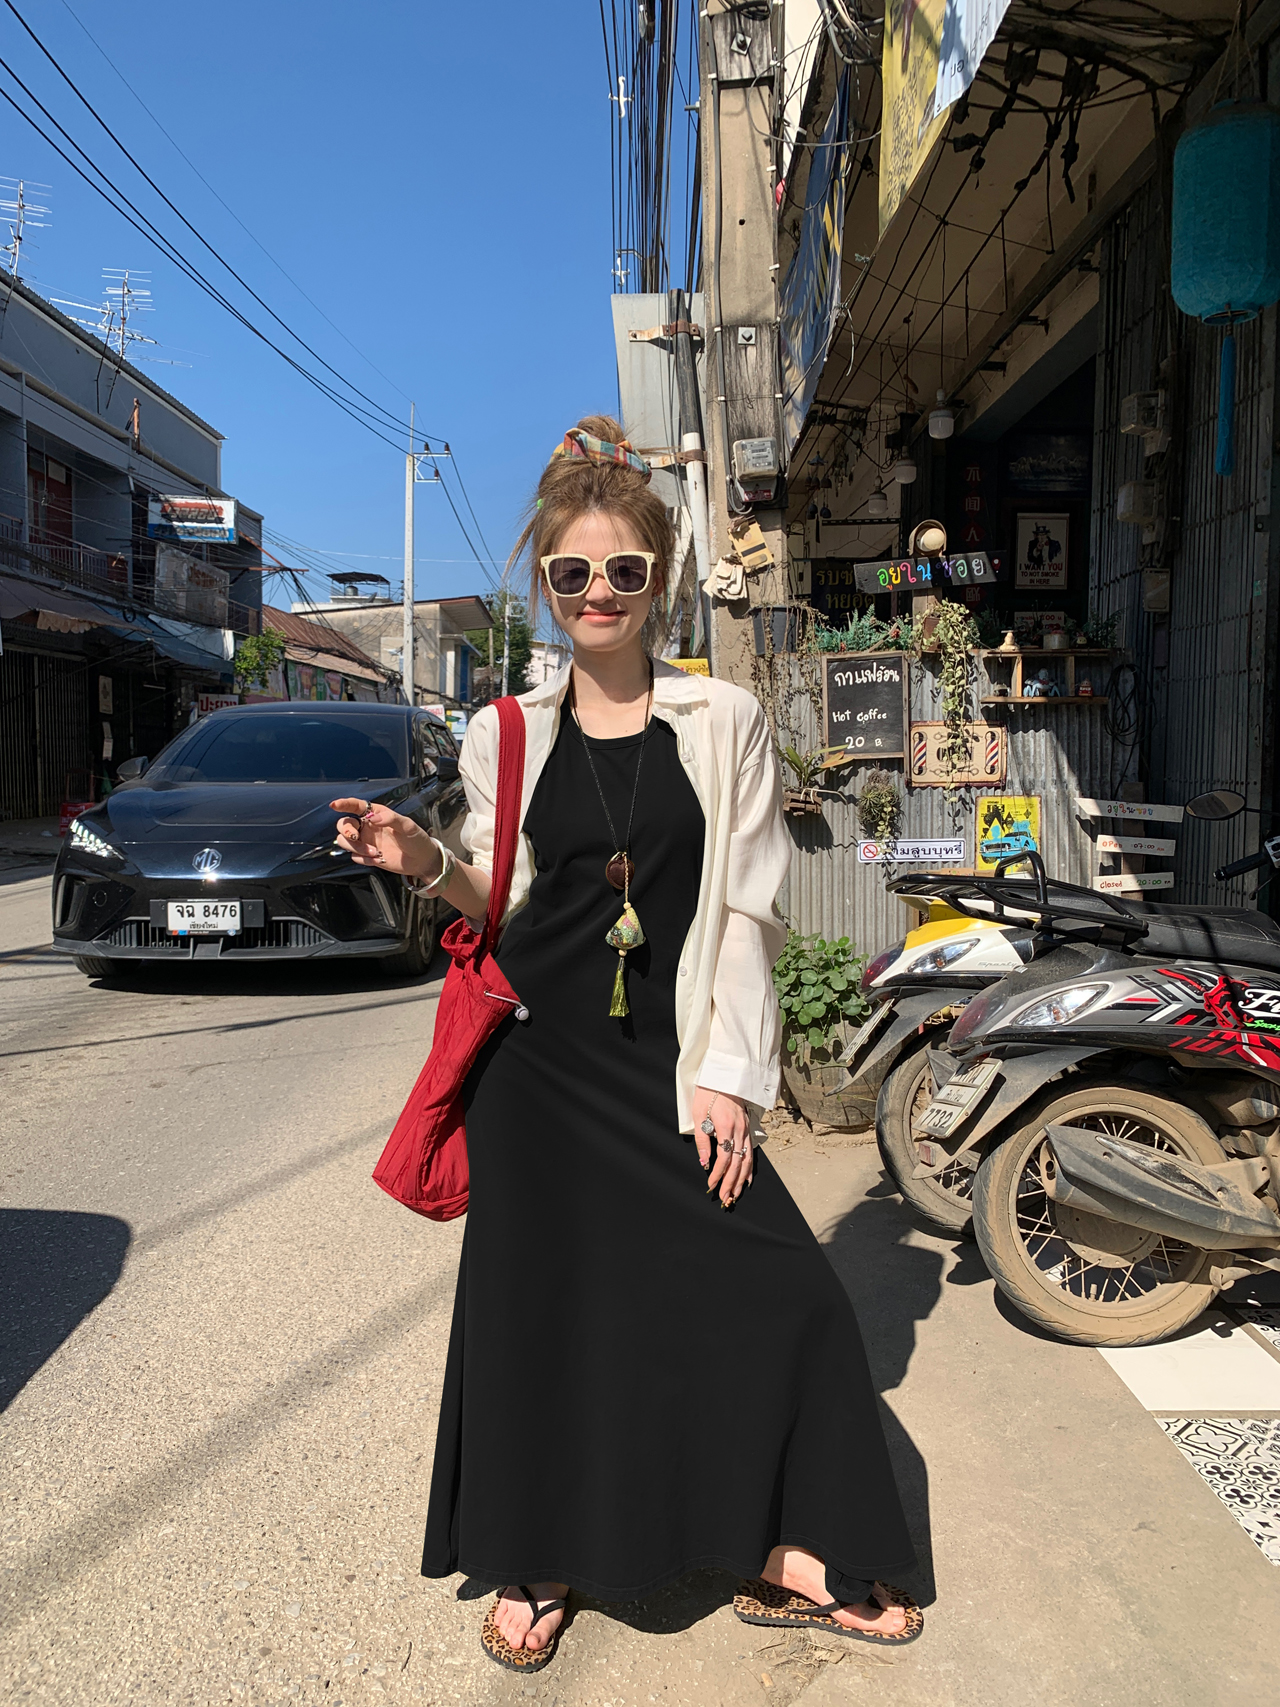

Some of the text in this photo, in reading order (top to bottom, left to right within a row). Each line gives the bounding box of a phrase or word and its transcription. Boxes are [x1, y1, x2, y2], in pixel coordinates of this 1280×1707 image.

[1047, 563, 1063, 571] YOU
[834, 661, 900, 687] กาแฟร้อน
[832, 709, 852, 723] Hot
[845, 736, 865, 749] 20
[194, 850, 220, 871] MG
[202, 905, 237, 918] 8476
[920, 1108, 954, 1128] 7732
